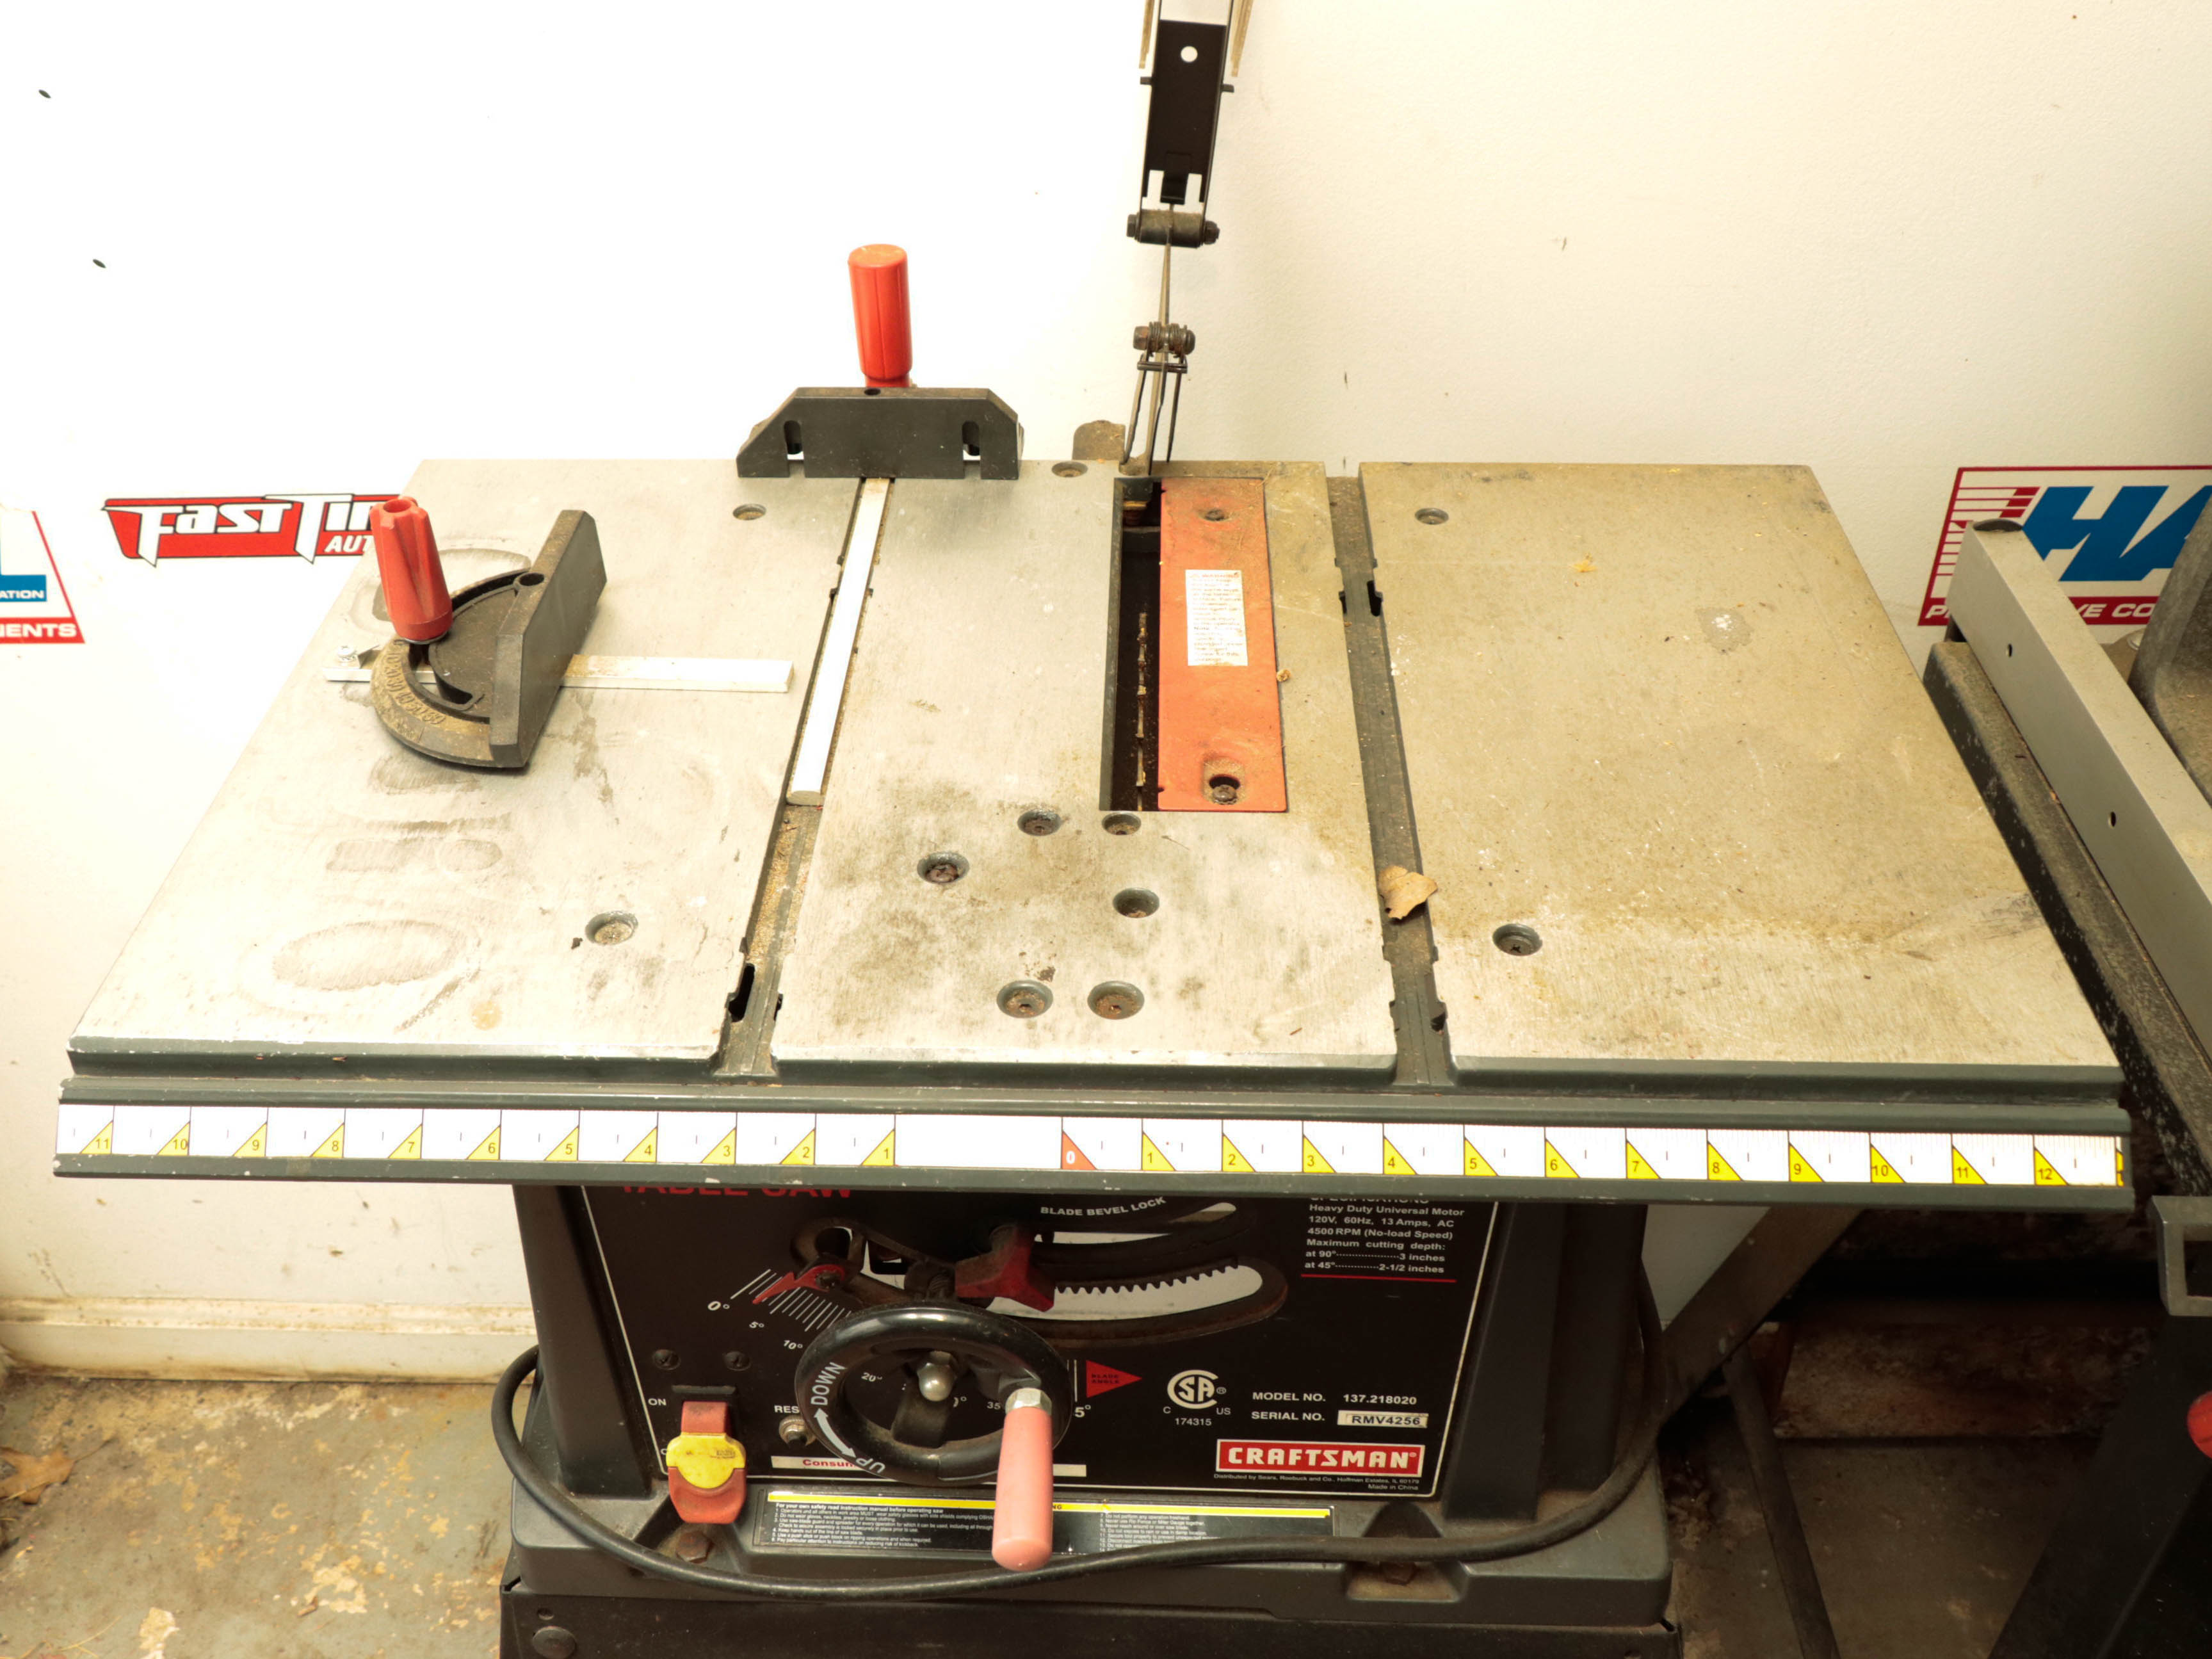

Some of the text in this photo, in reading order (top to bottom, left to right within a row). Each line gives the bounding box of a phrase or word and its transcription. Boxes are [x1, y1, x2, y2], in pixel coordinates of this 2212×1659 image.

[95, 1139, 109, 1150] 11
[172, 1139, 188, 1151] 10
[252, 1140, 260, 1151] 9
[332, 1140, 339, 1152] 8
[407, 1142, 416, 1153] 7
[488, 1143, 496, 1154] 6
[565, 1144, 573, 1155] 5
[644, 1145, 652, 1156] 4
[723, 1145, 731, 1157] 3
[802, 1147, 810, 1159] 2
[1065, 1151, 1076, 1164] 0
[1228, 1154, 1236, 1166] 2
[1307, 1155, 1315, 1167] 3
[1387, 1157, 1396, 1169] 4
[1469, 1158, 1478, 1170] 5
[1550, 1159, 1558, 1171] 6
[1632, 1161, 1640, 1173] 7
[1711, 1161, 1720, 1174] 8
[1793, 1163, 1802, 1176] 9
[1871, 1165, 1889, 1177] 10
[1956, 1167, 1969, 1179] 11
[2037, 1168, 2053, 1181] 12
[1040, 1196, 1167, 1216] BLADE BEVEL LOCK
[1309, 1204, 1465, 1216] Heavy Duty Universal Motor
[1396, 1218, 1431, 1228] Amps,
[1364, 1229, 1411, 1238] (No-load
[1414, 1231, 1453, 1240] Speed)
[1306, 1238, 1446, 1251] Maximum cutting depth:
[1409, 1254, 1445, 1262] inches
[1408, 1265, 1444, 1273] inches
[707, 1300, 730, 1311] 0°
[811, 1362, 846, 1405] DOWN
[1252, 1392, 1417, 1405] MODEL NO. 137.218020
[1251, 1411, 1421, 1425] SERIAL NO. RMV4256
[855, 1457, 885, 1473] UP
